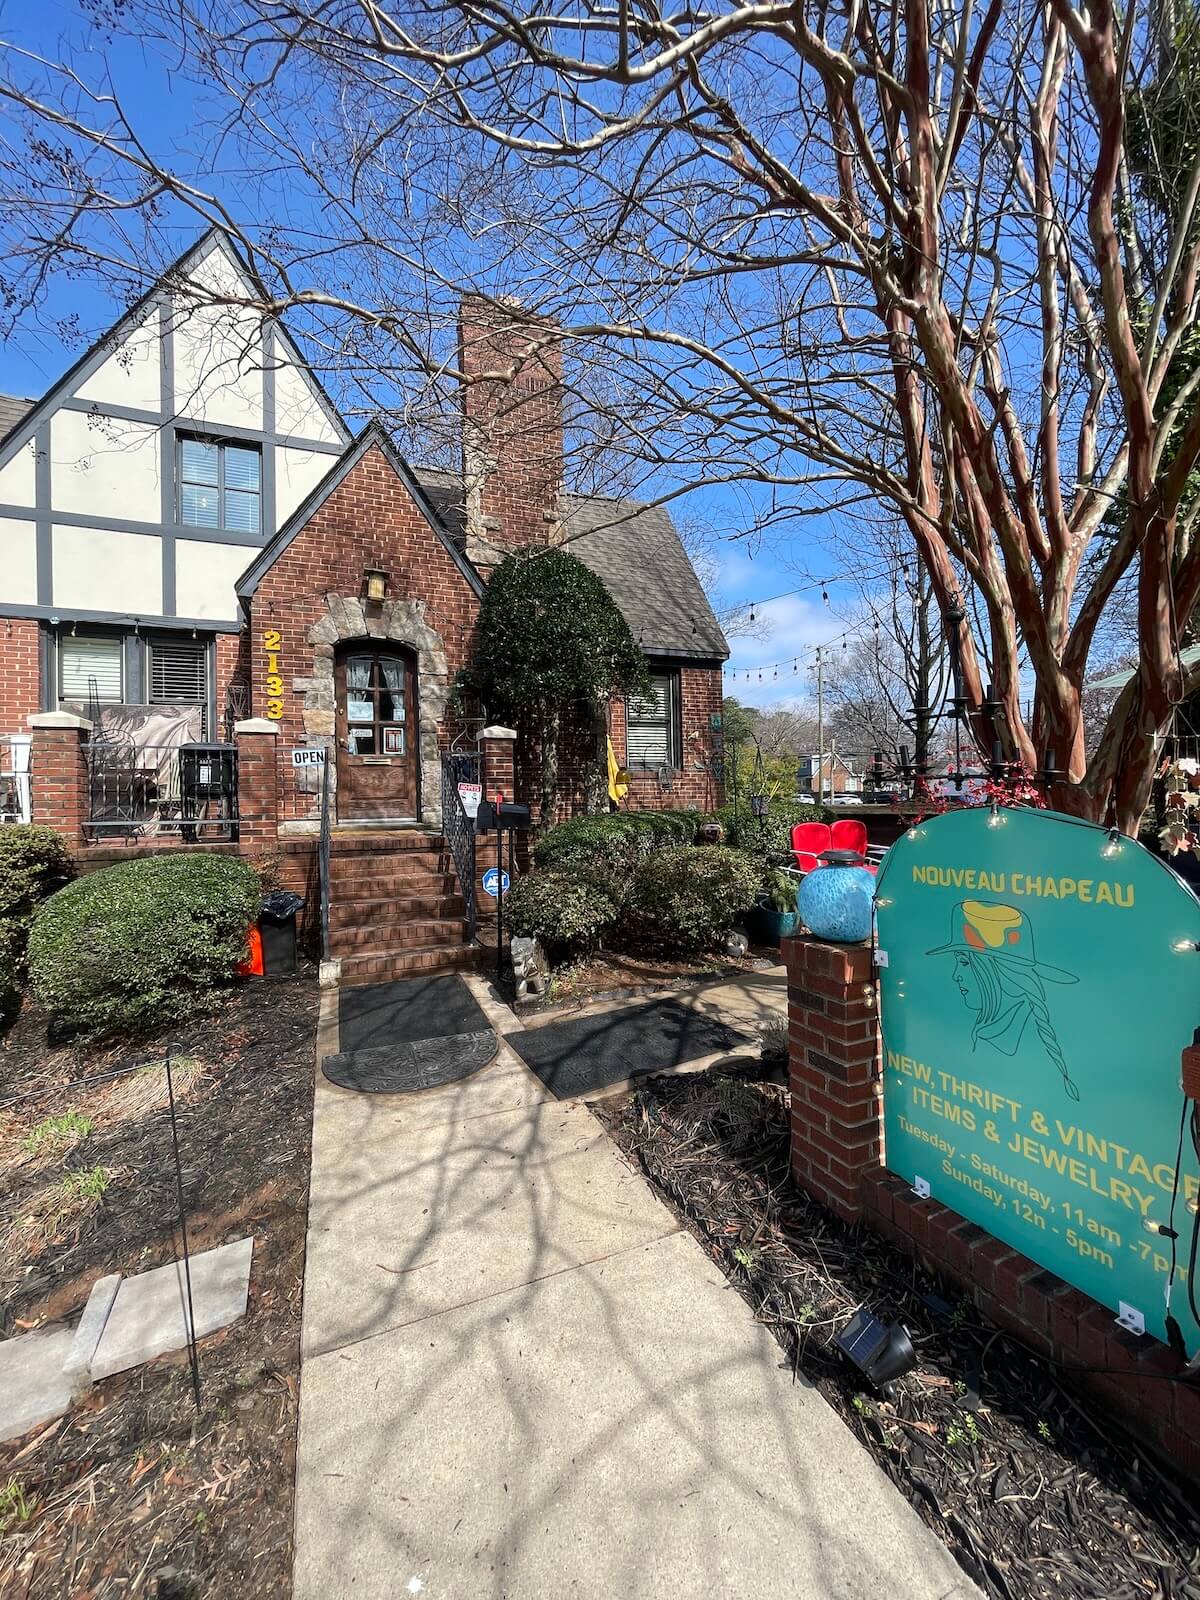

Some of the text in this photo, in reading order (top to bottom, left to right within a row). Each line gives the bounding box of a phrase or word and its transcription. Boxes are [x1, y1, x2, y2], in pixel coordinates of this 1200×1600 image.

[264, 631, 284, 720] 2133
[294, 751, 324, 764] OPEN
[912, 864, 1135, 907] NOUVEAU CHAPEAU
[887, 1053, 1200, 1199] NEW, THRIFT & VINTAGE
[897, 1114, 956, 1159] Tuesday
[970, 1153, 1055, 1213] Saturday,
[1061, 1202, 1122, 1247] 11am
[912, 1086, 1156, 1217] ITEMS & JEWELRY
[941, 1159, 1007, 1209] Sunday,
[1012, 1198, 1046, 1230] 12n
[1066, 1230, 1114, 1269] 5pm
